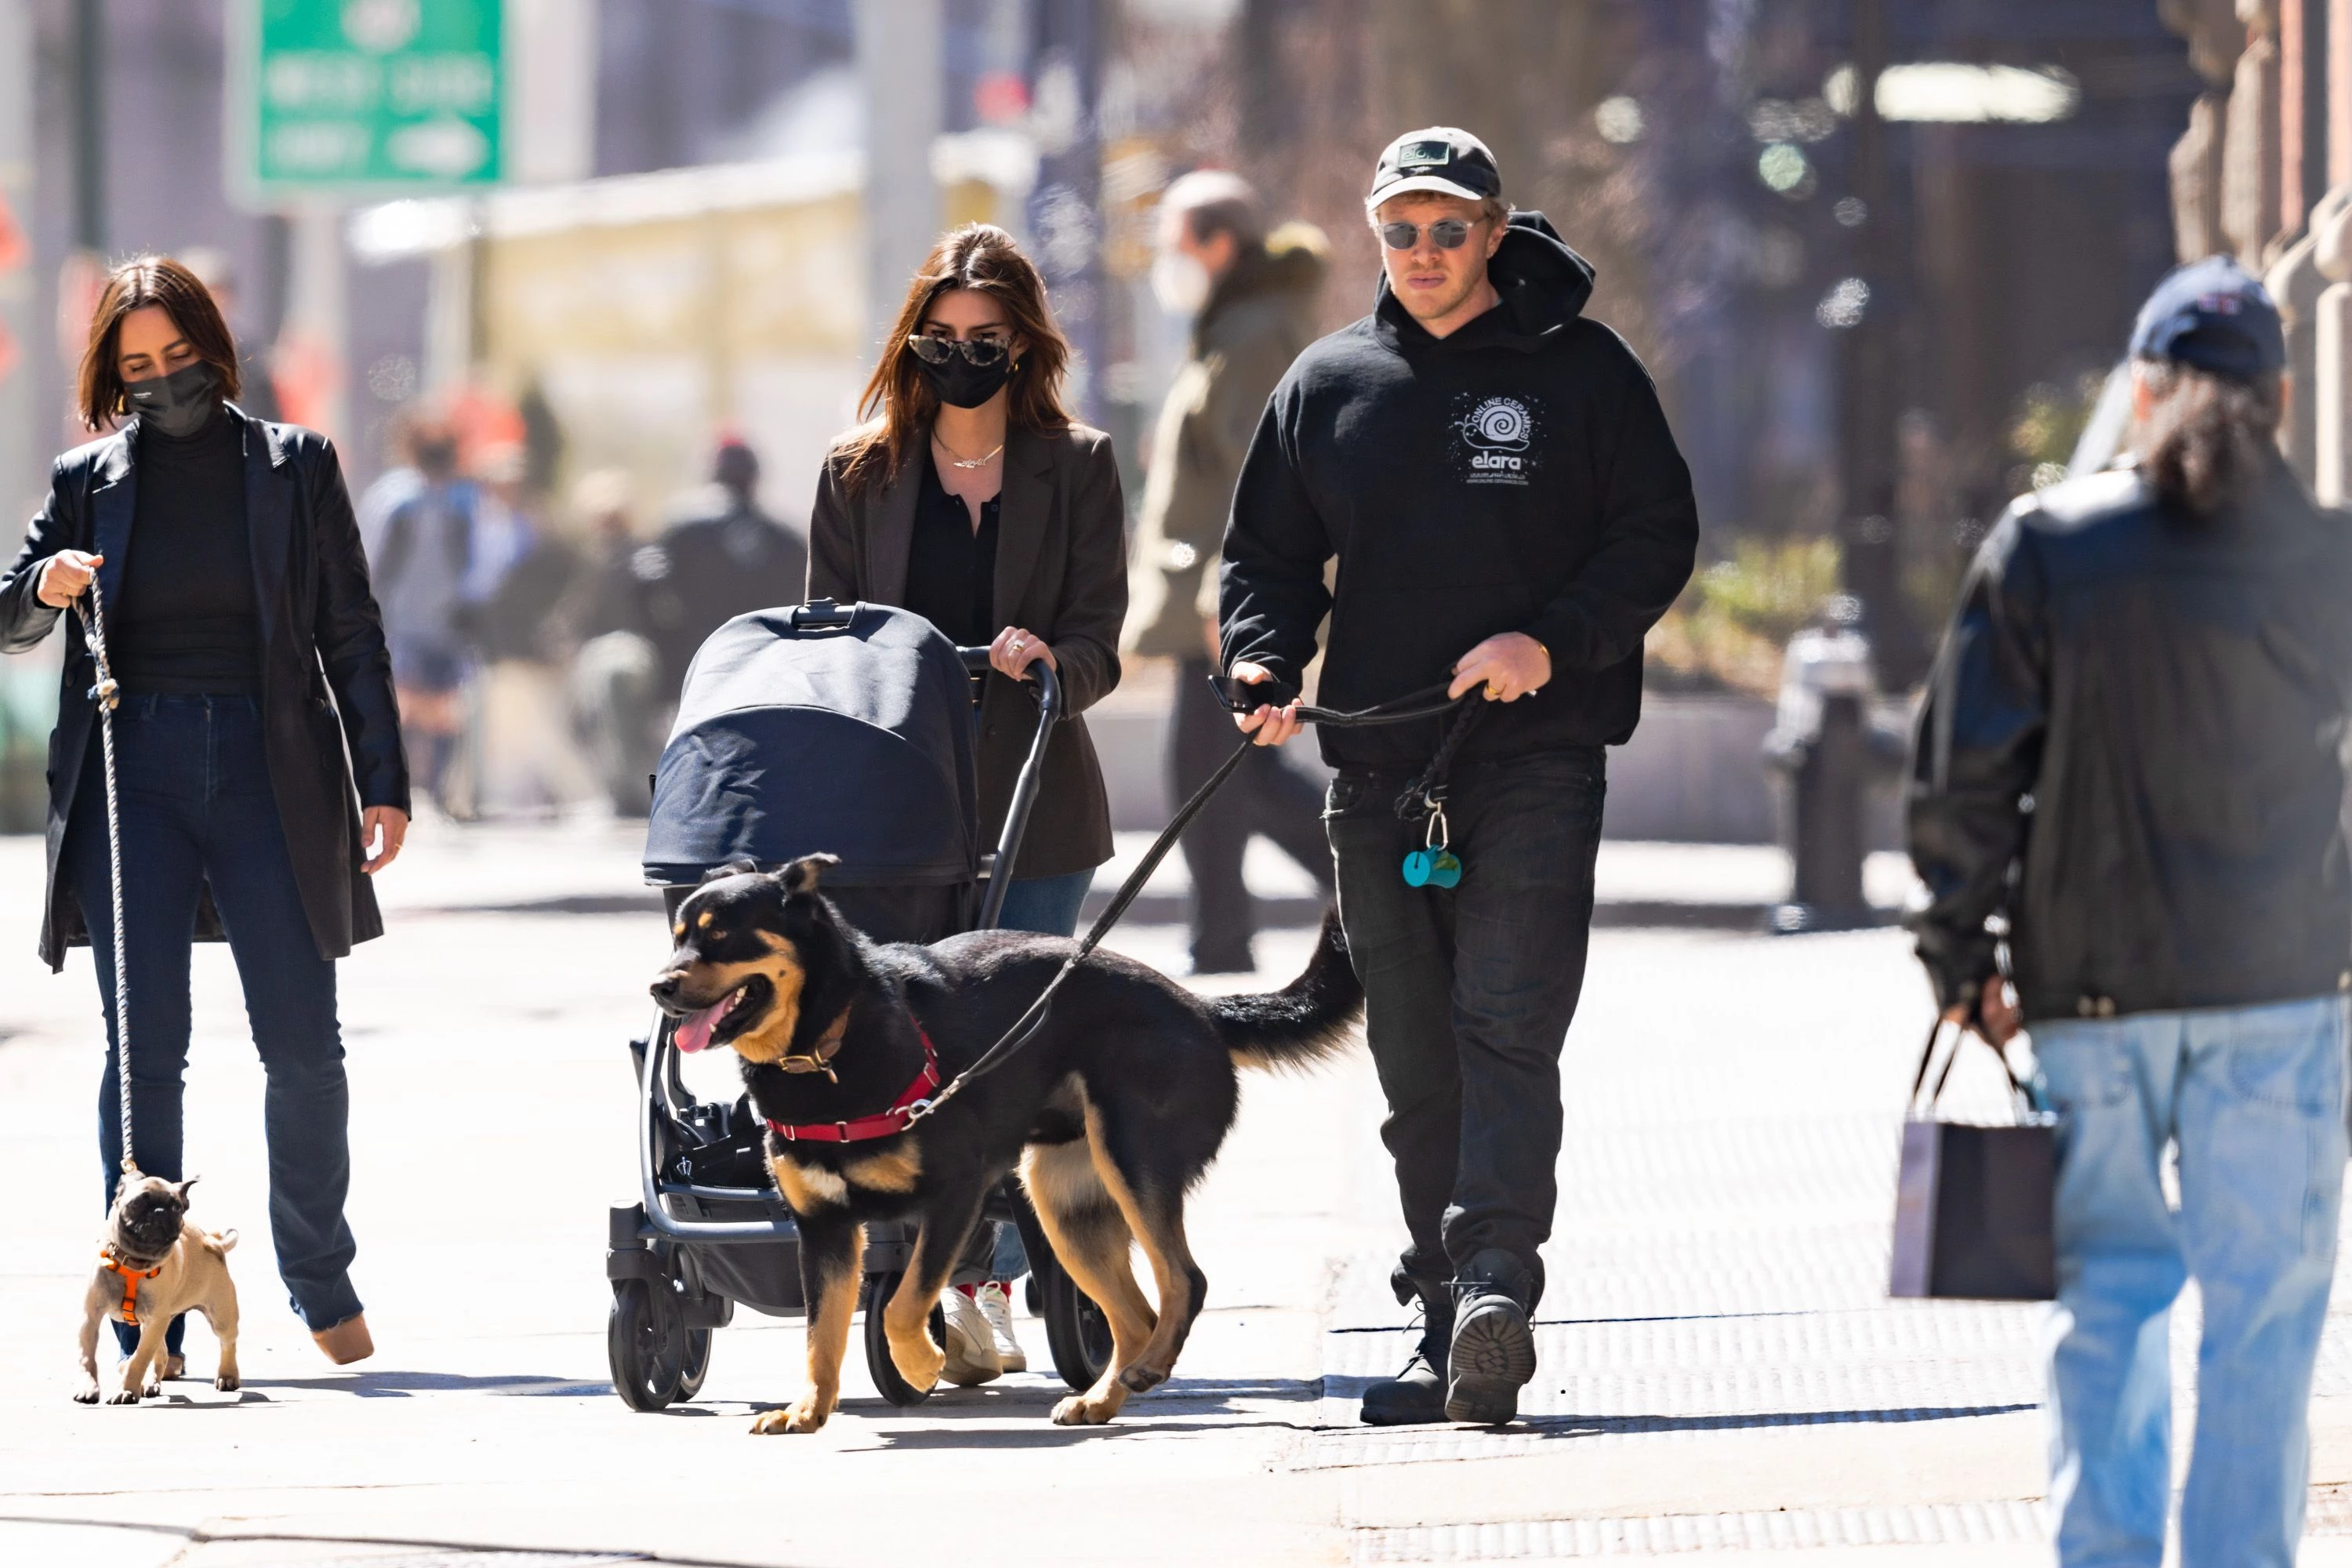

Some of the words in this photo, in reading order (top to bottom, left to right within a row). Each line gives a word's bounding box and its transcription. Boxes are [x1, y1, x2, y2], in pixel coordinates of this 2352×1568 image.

[1472, 397, 1502, 423] ONLINE
[1504, 397, 1531, 440] CERAMICS
[1472, 450, 1521, 470] elara
